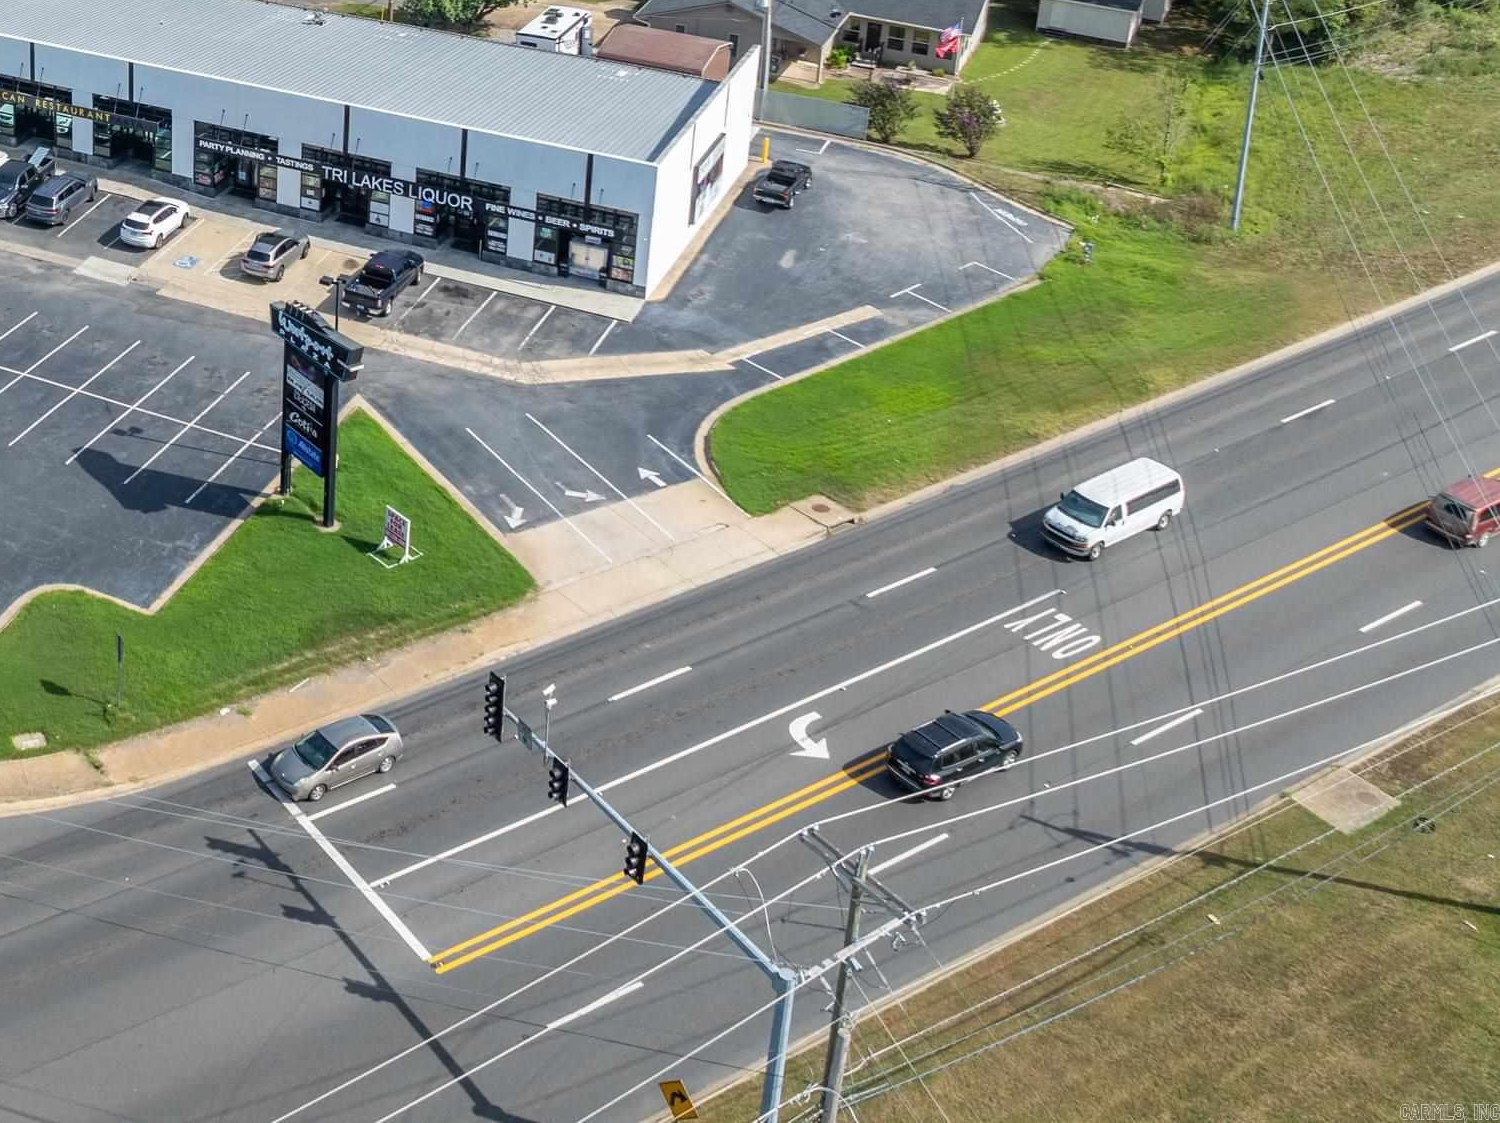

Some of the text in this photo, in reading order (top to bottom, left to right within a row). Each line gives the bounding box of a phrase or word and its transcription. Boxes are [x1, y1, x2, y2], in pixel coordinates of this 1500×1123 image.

[35, 99, 111, 122] RESTAURANT
[199, 139, 314, 171] PARTY PLANNING TASTINGS
[322, 165, 473, 211] TRI LAKES LIQUOR
[485, 203, 615, 237] FINE WINES BEER SPIRITS
[1003, 607, 1101, 660] ONLY
